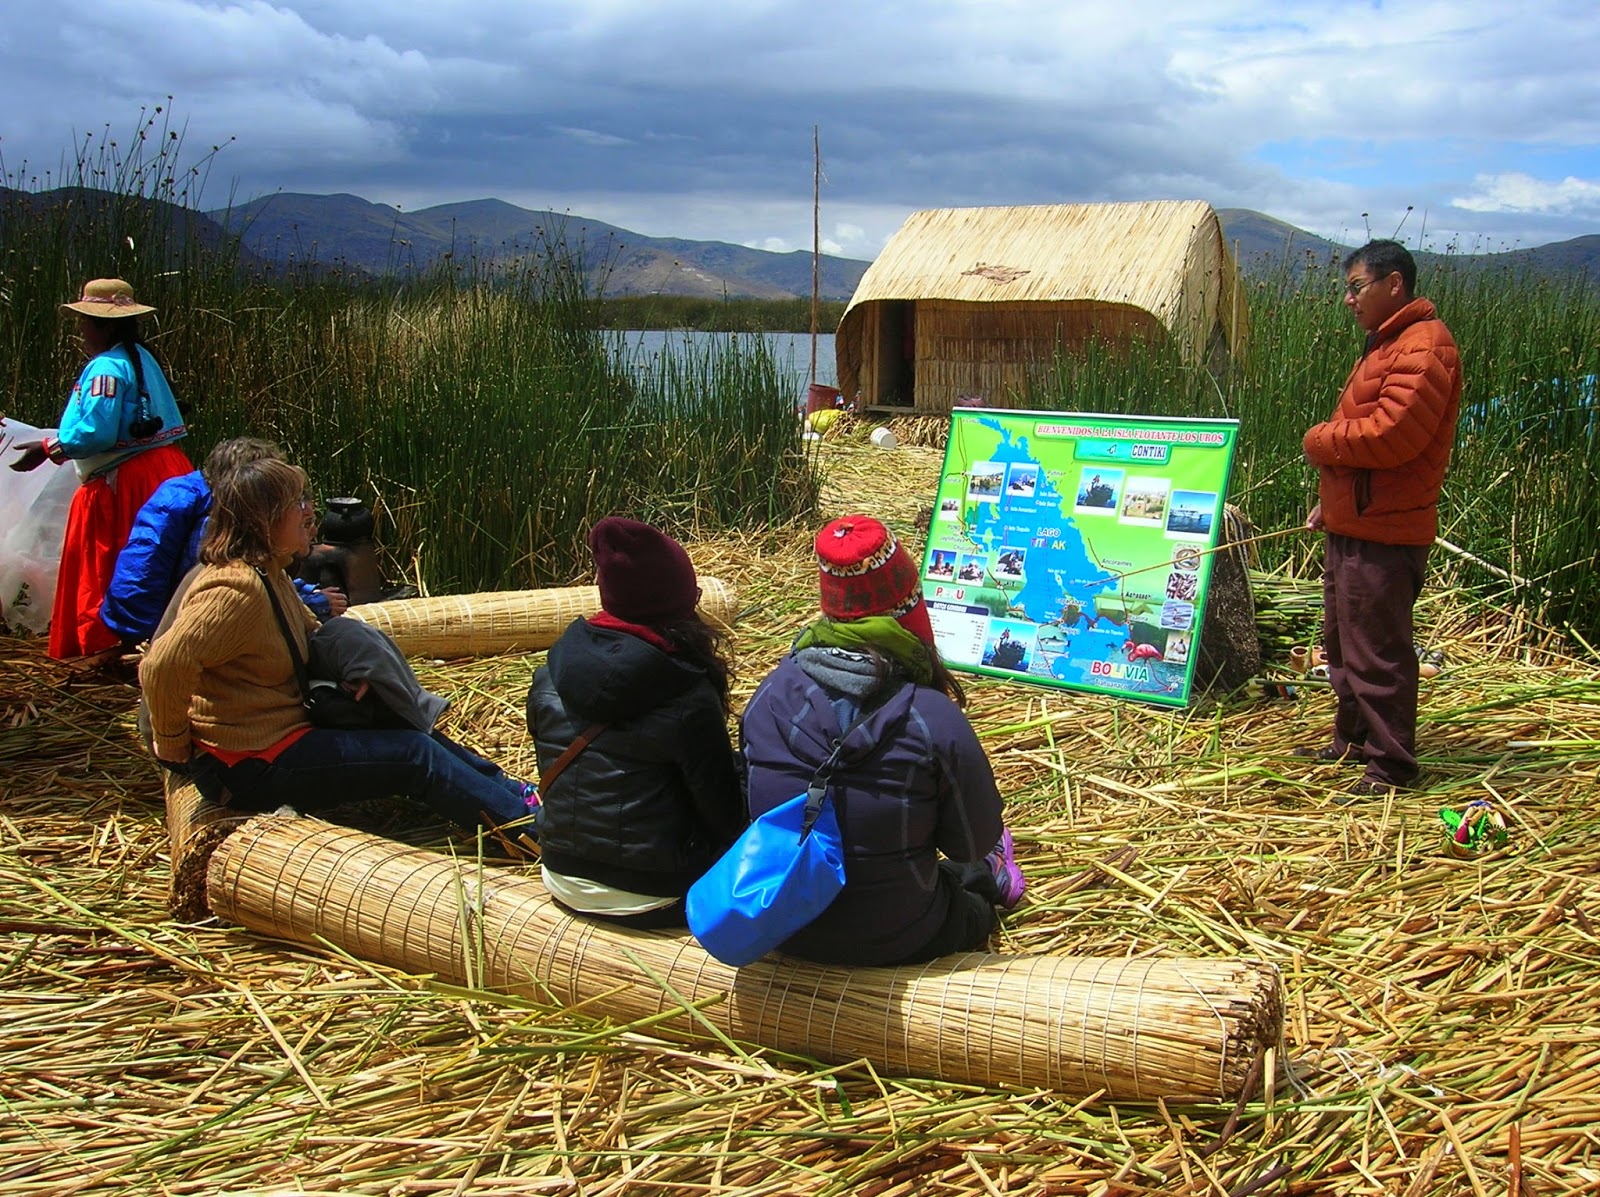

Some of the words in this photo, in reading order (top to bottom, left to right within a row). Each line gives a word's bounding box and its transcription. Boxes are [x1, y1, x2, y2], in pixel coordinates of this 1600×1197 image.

[1037, 425, 1092, 436] BIENVENIDOS
[1094, 428, 1100, 436] A
[1102, 428, 1112, 437] LA
[1113, 429, 1132, 438] ISLA
[1134, 430, 1177, 440] FLOTANTE
[1180, 432, 1196, 441] LOS
[1199, 433, 1224, 443] UROS
[1132, 445, 1166, 458] CONTIKI
[1038, 527, 1060, 537] LAGO
[1091, 660, 1149, 681] BOLIVIA
